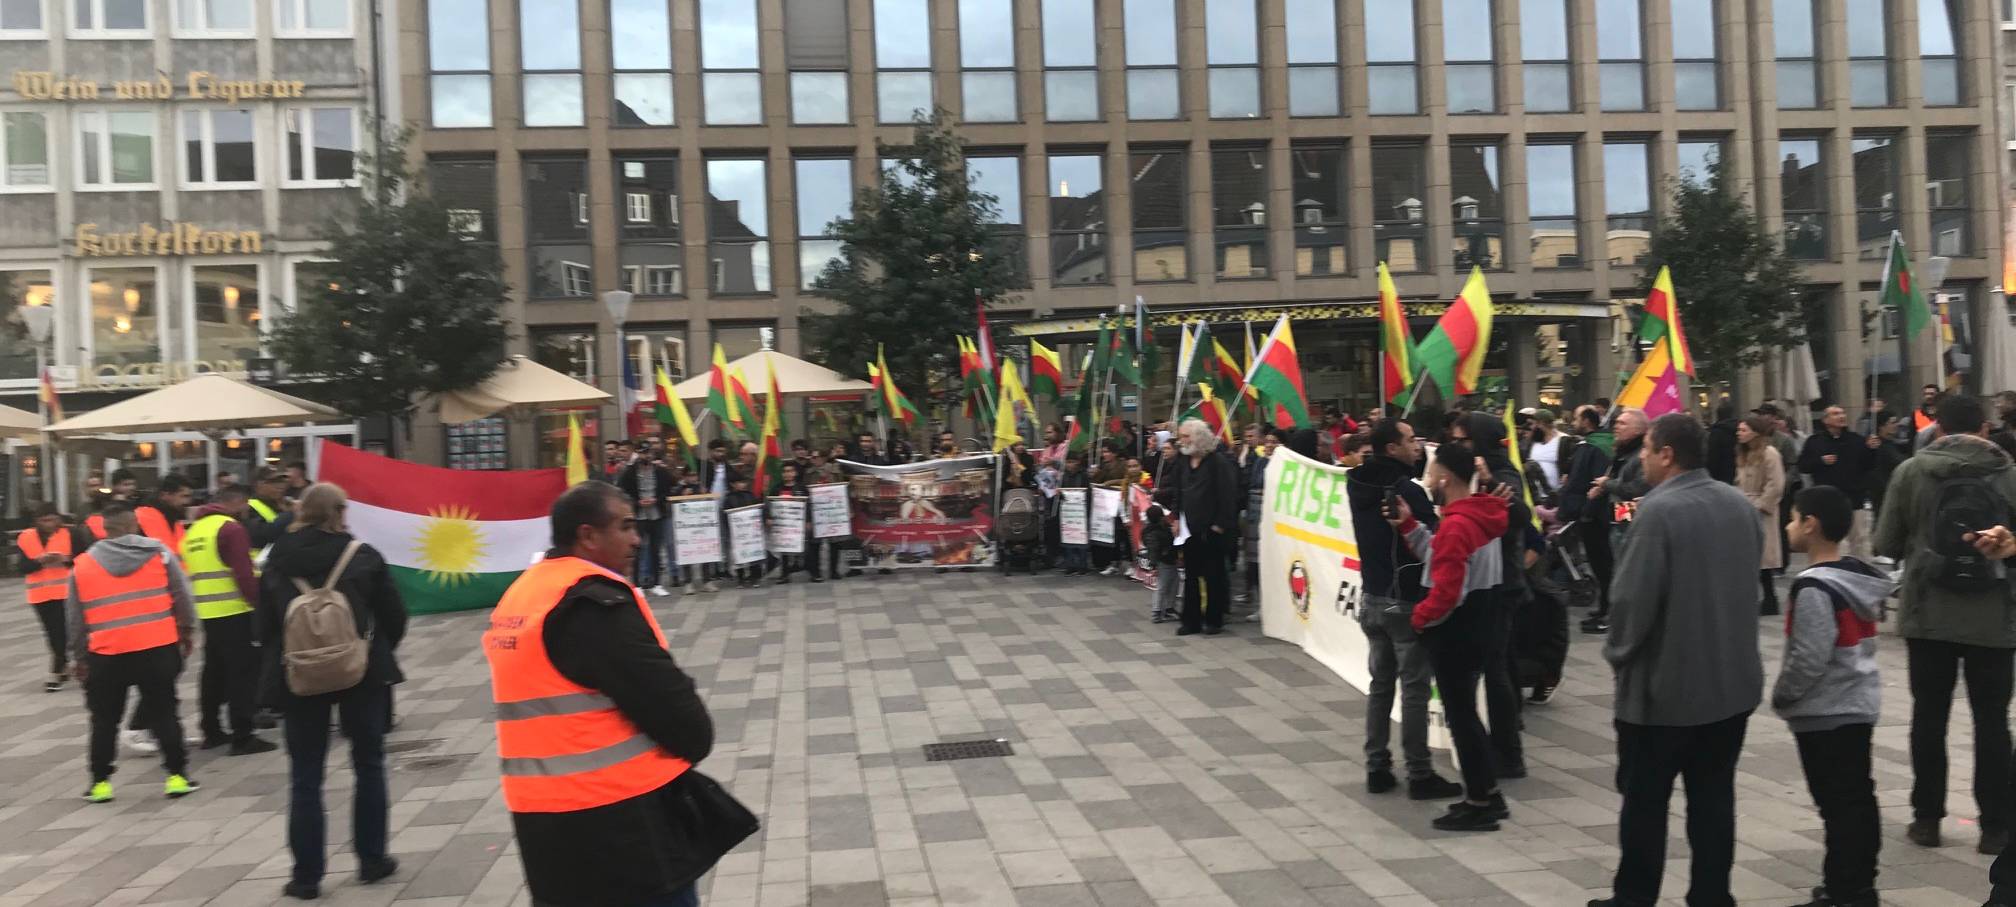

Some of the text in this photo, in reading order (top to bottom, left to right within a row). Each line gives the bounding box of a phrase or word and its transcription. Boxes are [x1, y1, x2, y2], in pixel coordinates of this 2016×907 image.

[14, 70, 98, 100] Wein
[114, 73, 173, 100] und
[1274, 459, 1347, 530] RISE
[1335, 580, 1361, 623] FA
